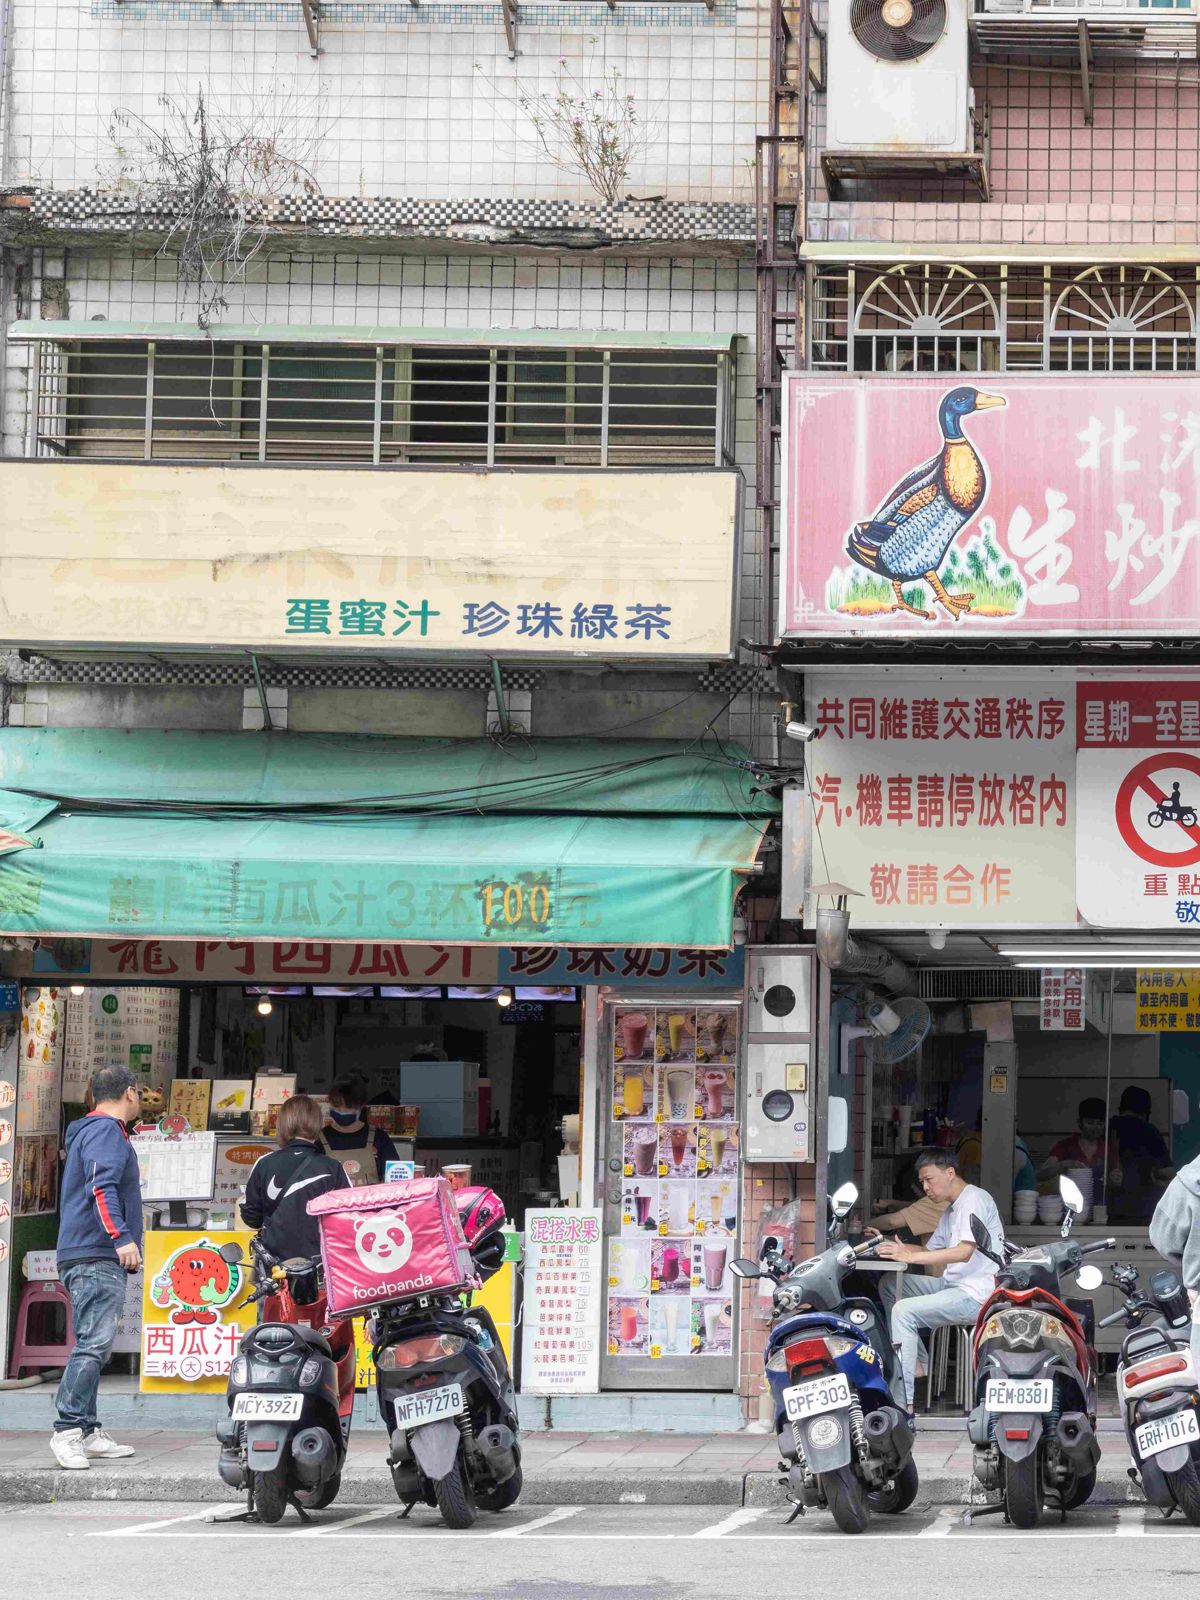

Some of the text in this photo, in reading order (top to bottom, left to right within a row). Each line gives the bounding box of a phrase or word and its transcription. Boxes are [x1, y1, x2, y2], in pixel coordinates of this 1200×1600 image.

[286, 599, 672, 640] 蛋蜜汁 珍珠綠茶
[815, 697, 1065, 740] 共同維護交通秩序
[869, 863, 1012, 905] 敬請合作
[107, 939, 728, 978] 龍門西瓜汁 珍珠奶茶
[1063, 967, 1081, 1028] 內用區
[532, 1218, 599, 1242] 混搭水果
[351, 1272, 434, 1300] foodpanda
[147, 1325, 243, 1357] 西瓜汁
[856, 1344, 876, 1365] 46
[397, 1392, 460, 1422] NFH-7278
[786, 1384, 848, 1415] CPF-303
[988, 1387, 1048, 1404] PEM-8381
[1138, 1417, 1197, 1453] ERH-1016
